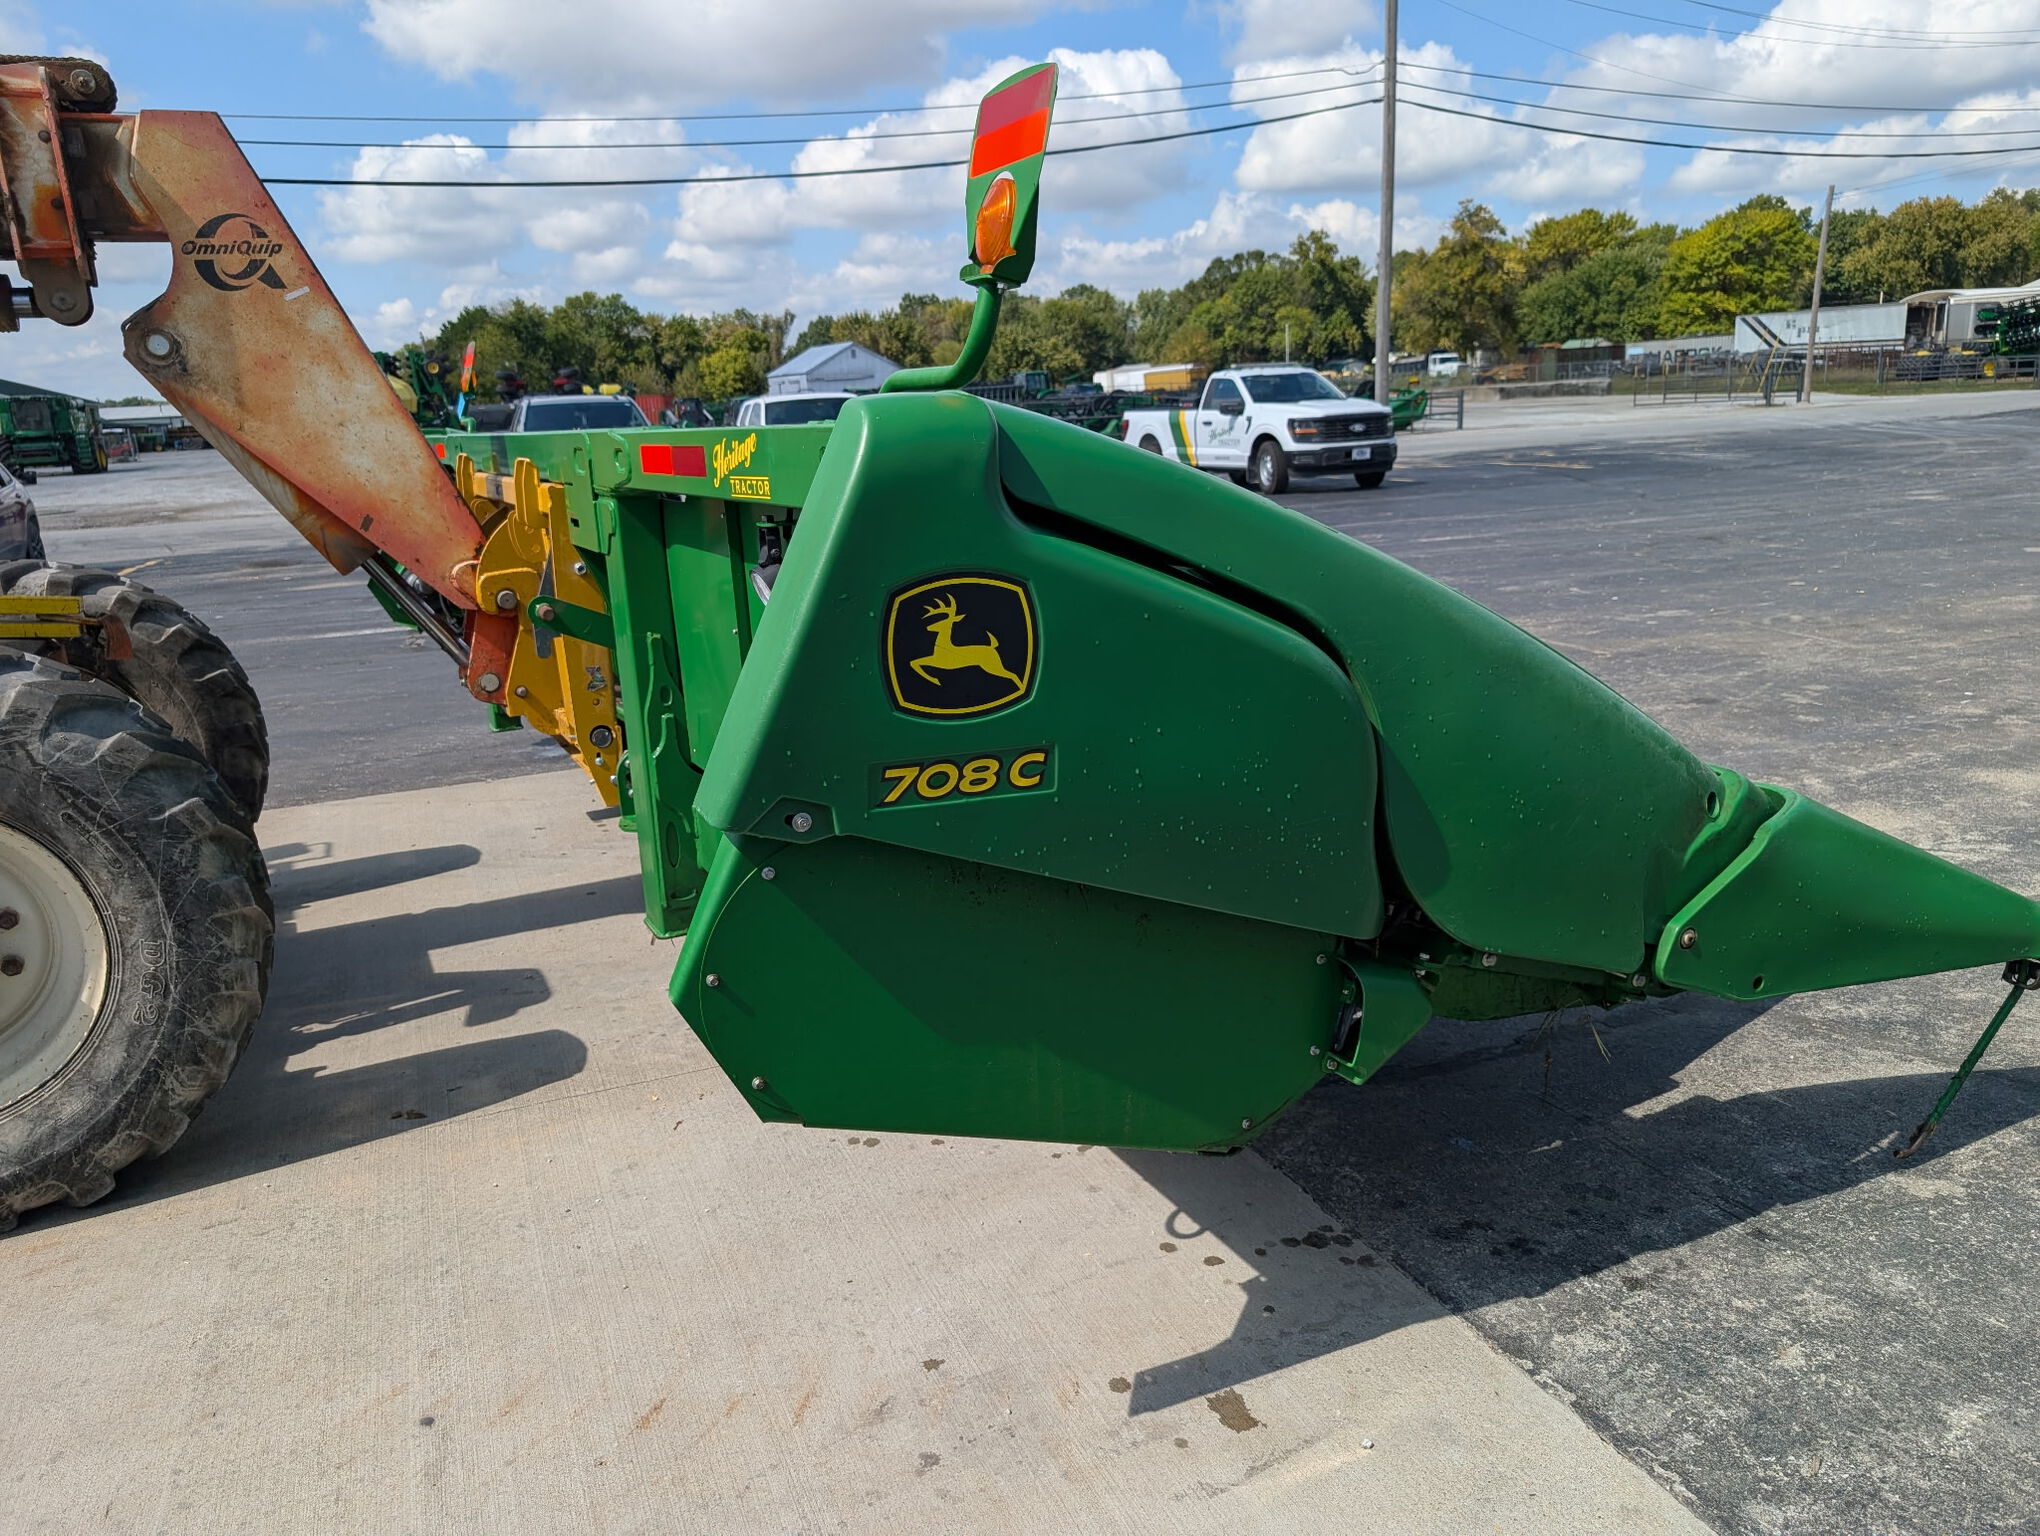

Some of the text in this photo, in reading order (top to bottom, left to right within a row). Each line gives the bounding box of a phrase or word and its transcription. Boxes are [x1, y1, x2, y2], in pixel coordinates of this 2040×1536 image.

[181, 240, 283, 258] OmniQuip
[712, 432, 758, 488] Heritage
[729, 479, 771, 496] TRACTOR
[879, 751, 1048, 805] 708 C
